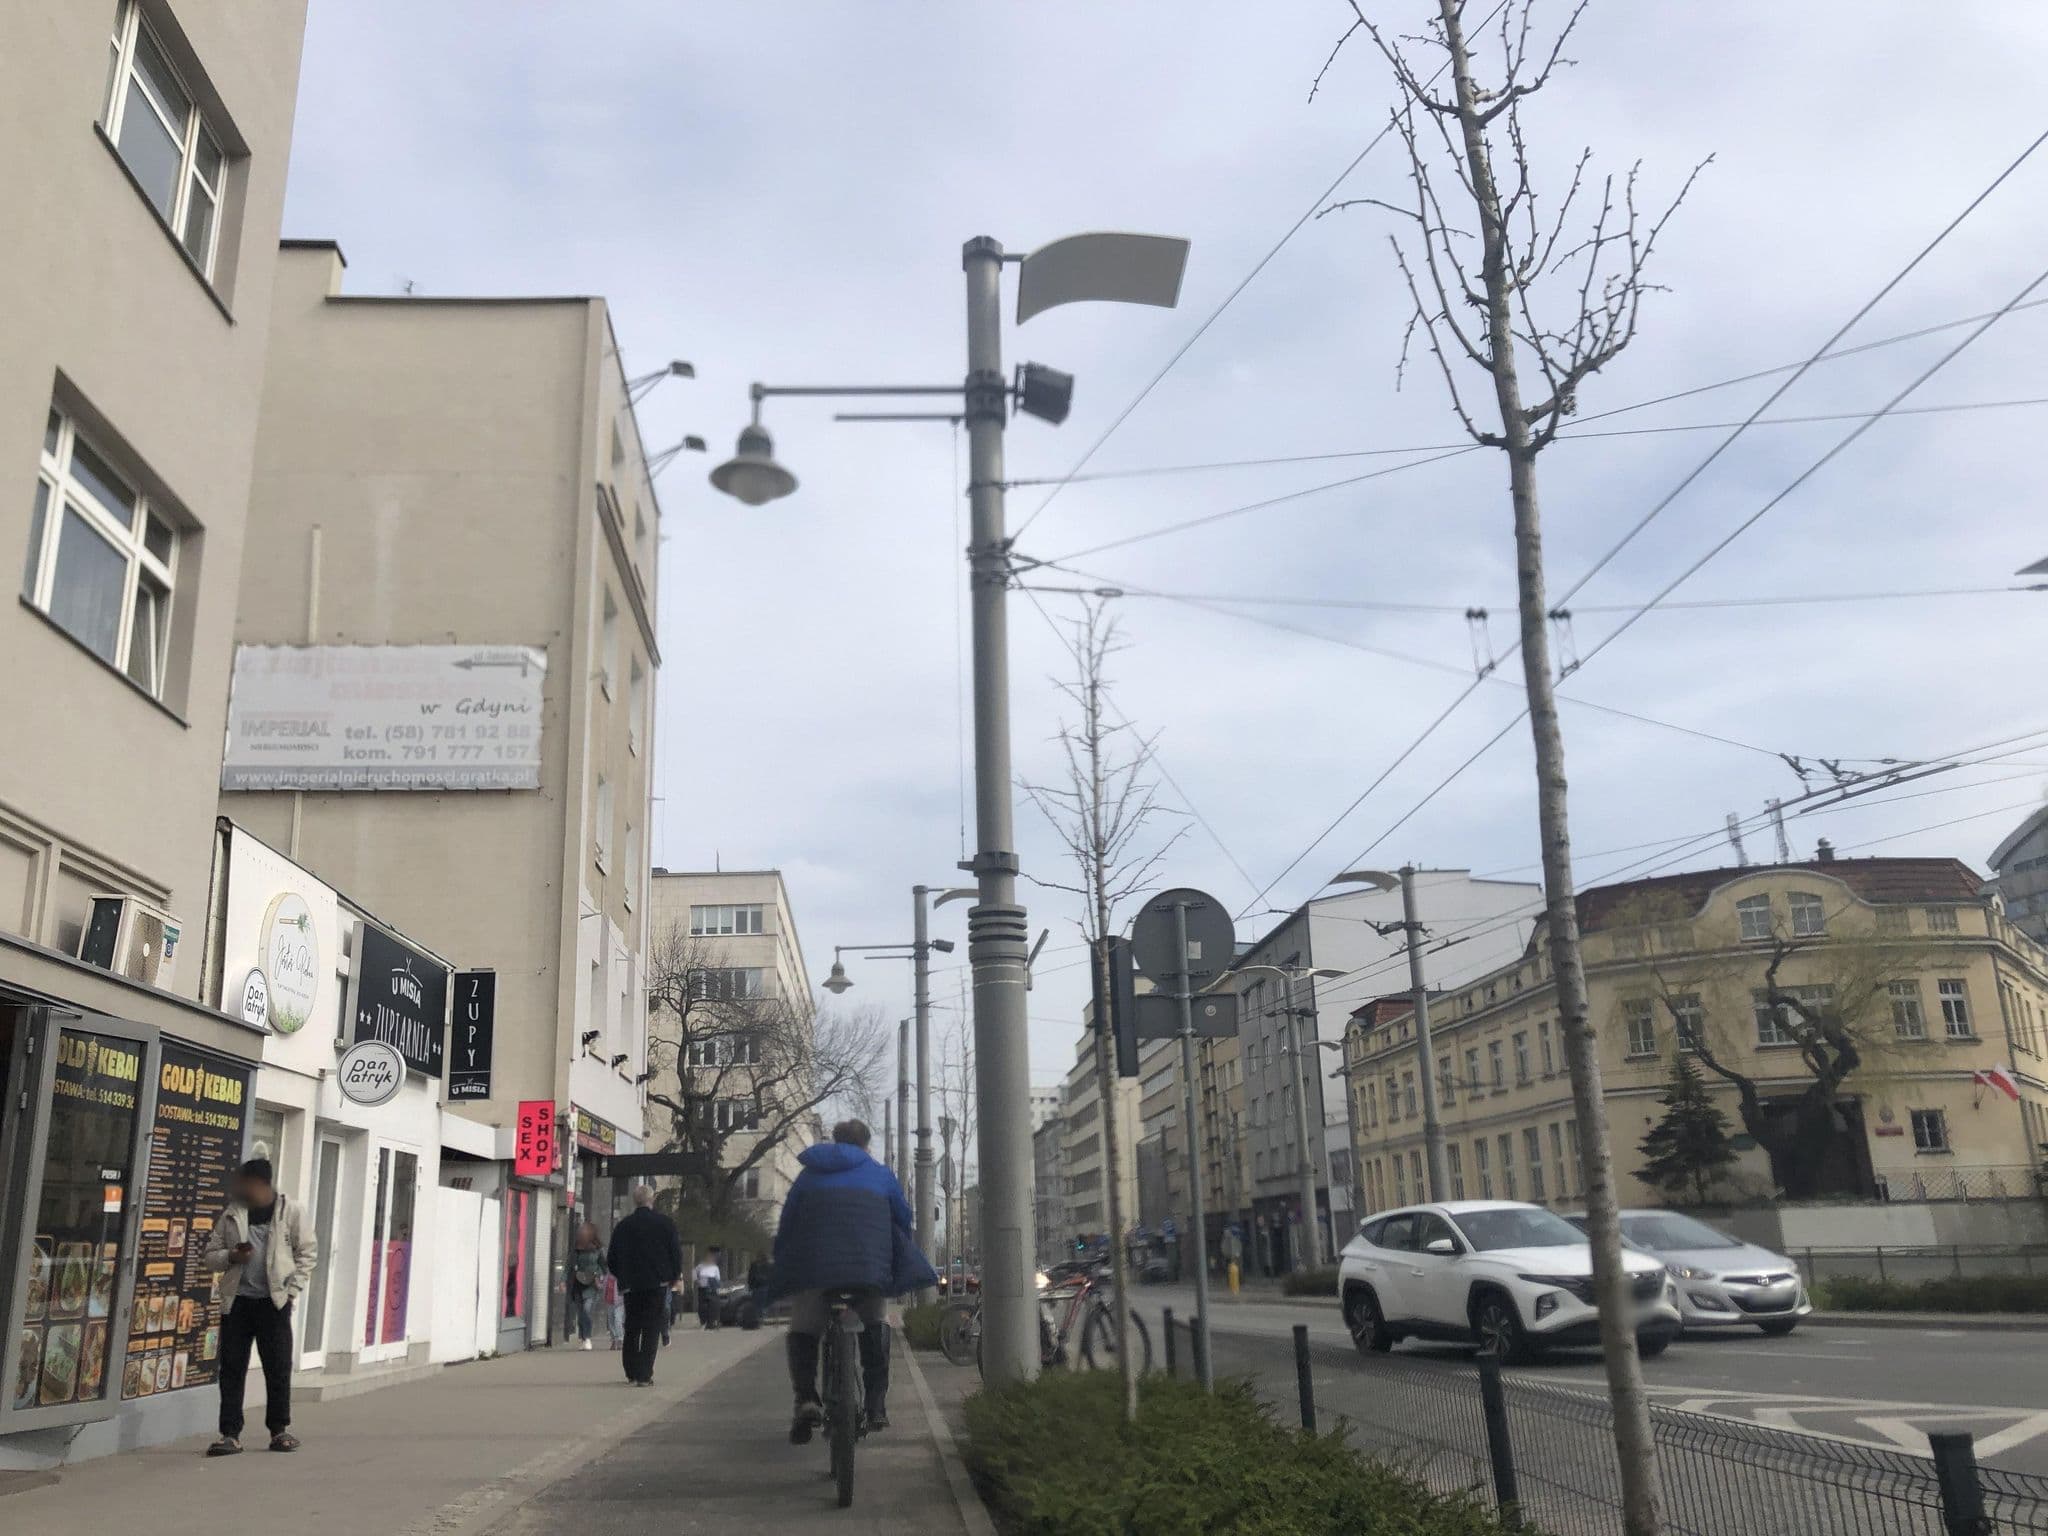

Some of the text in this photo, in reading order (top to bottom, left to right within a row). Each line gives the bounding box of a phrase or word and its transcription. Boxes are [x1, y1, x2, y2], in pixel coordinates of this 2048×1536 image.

[455, 696, 532, 718] Gdyni
[240, 719, 331, 737] IMPERIAL
[345, 725, 378, 740] tel.
[385, 725, 424, 743] (58)
[343, 745, 392, 760] kom.
[402, 745, 438, 760] 791
[448, 745, 484, 760] 777
[247, 985, 265, 1003] Pan
[391, 976, 422, 1009] U MISIA
[374, 1003, 431, 1065] ZUPIARNIA
[467, 979, 480, 1067] ZUPY
[57, 1035, 87, 1069] OLD
[352, 1058, 388, 1076] Pan
[54, 1079, 85, 1100] STAWA:
[161, 1063, 242, 1105] GOLD KEBAB
[451, 1085, 487, 1095] U MISIA
[520, 1116, 532, 1161] SEX
[536, 1107, 550, 1168] SHOP
